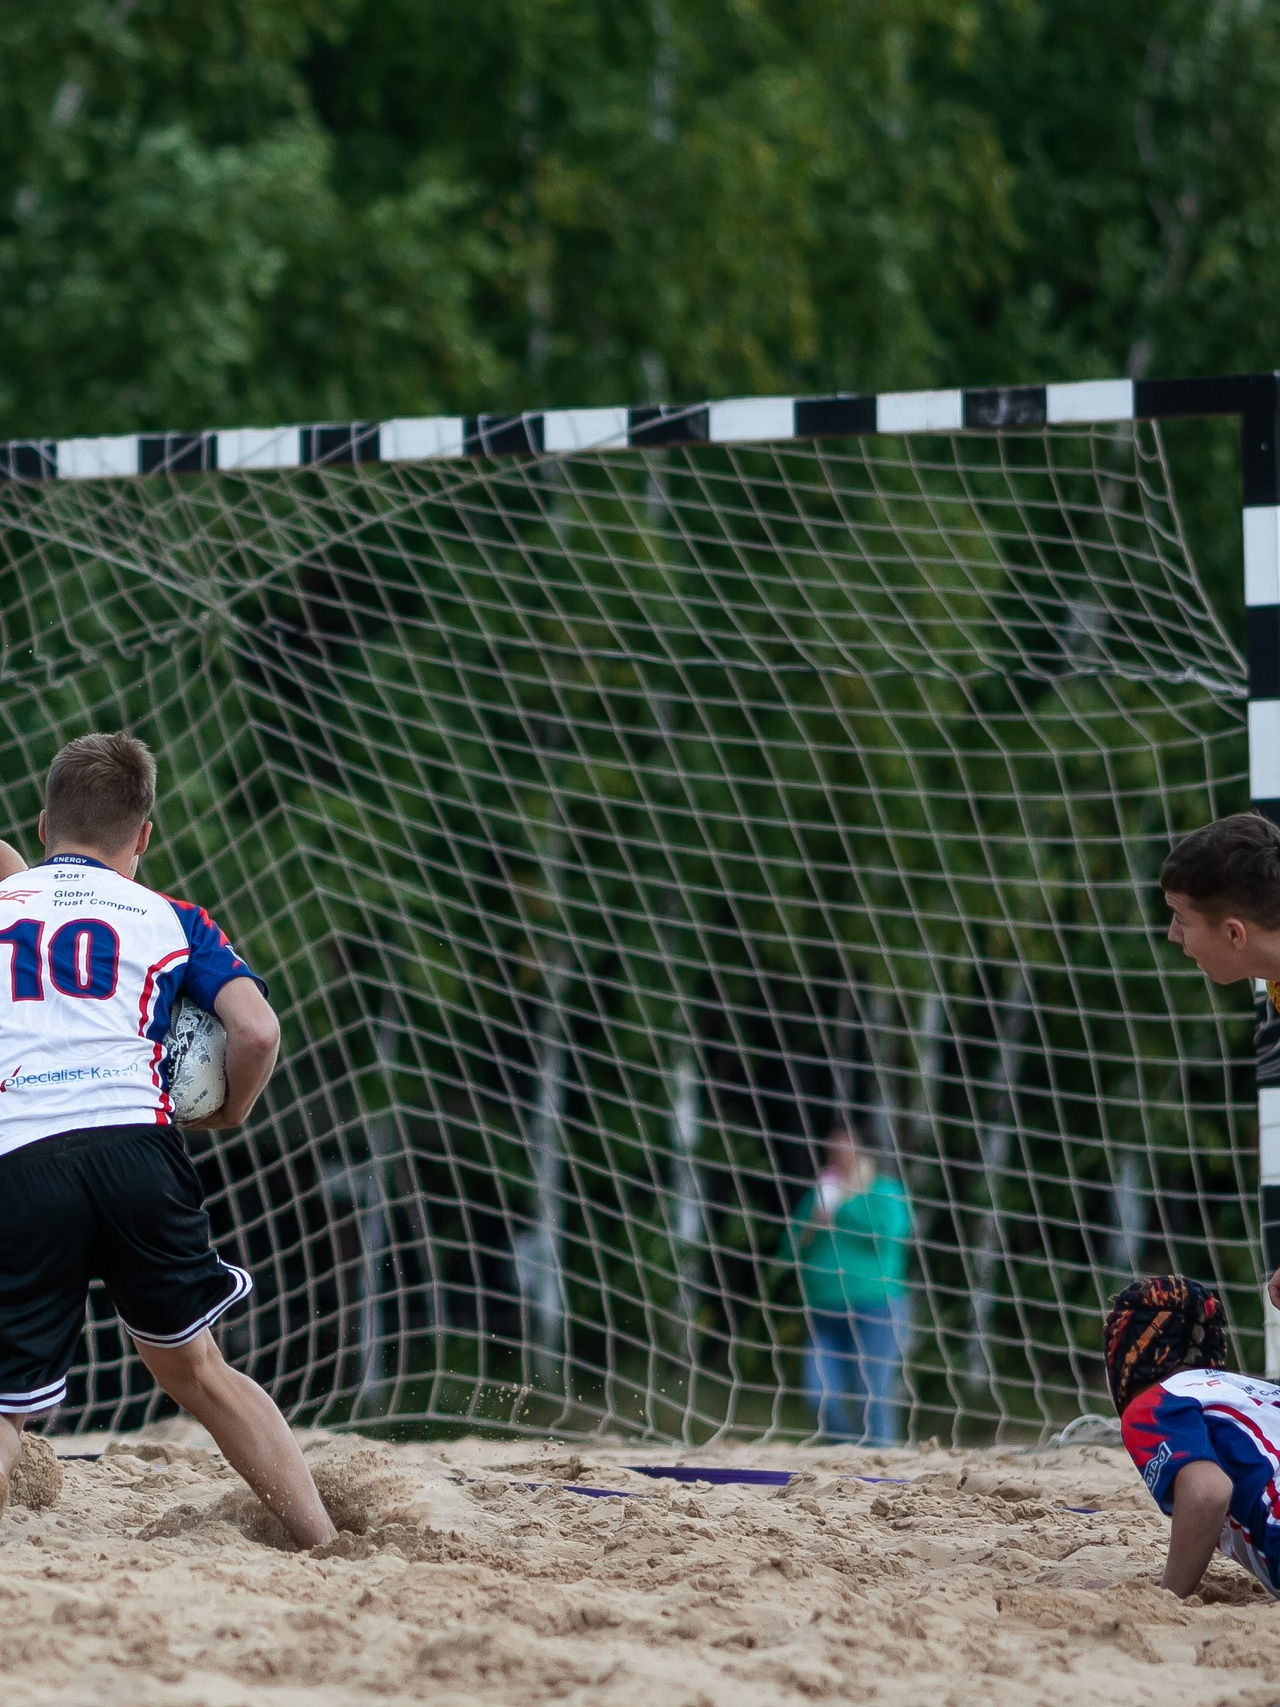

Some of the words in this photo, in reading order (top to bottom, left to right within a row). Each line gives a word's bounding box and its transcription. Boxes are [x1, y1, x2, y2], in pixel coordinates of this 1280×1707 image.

[53, 856, 87, 864] ENERGY
[54, 890, 95, 898] Global
[52, 899, 83, 907] Trust
[89, 898, 148, 916] Company
